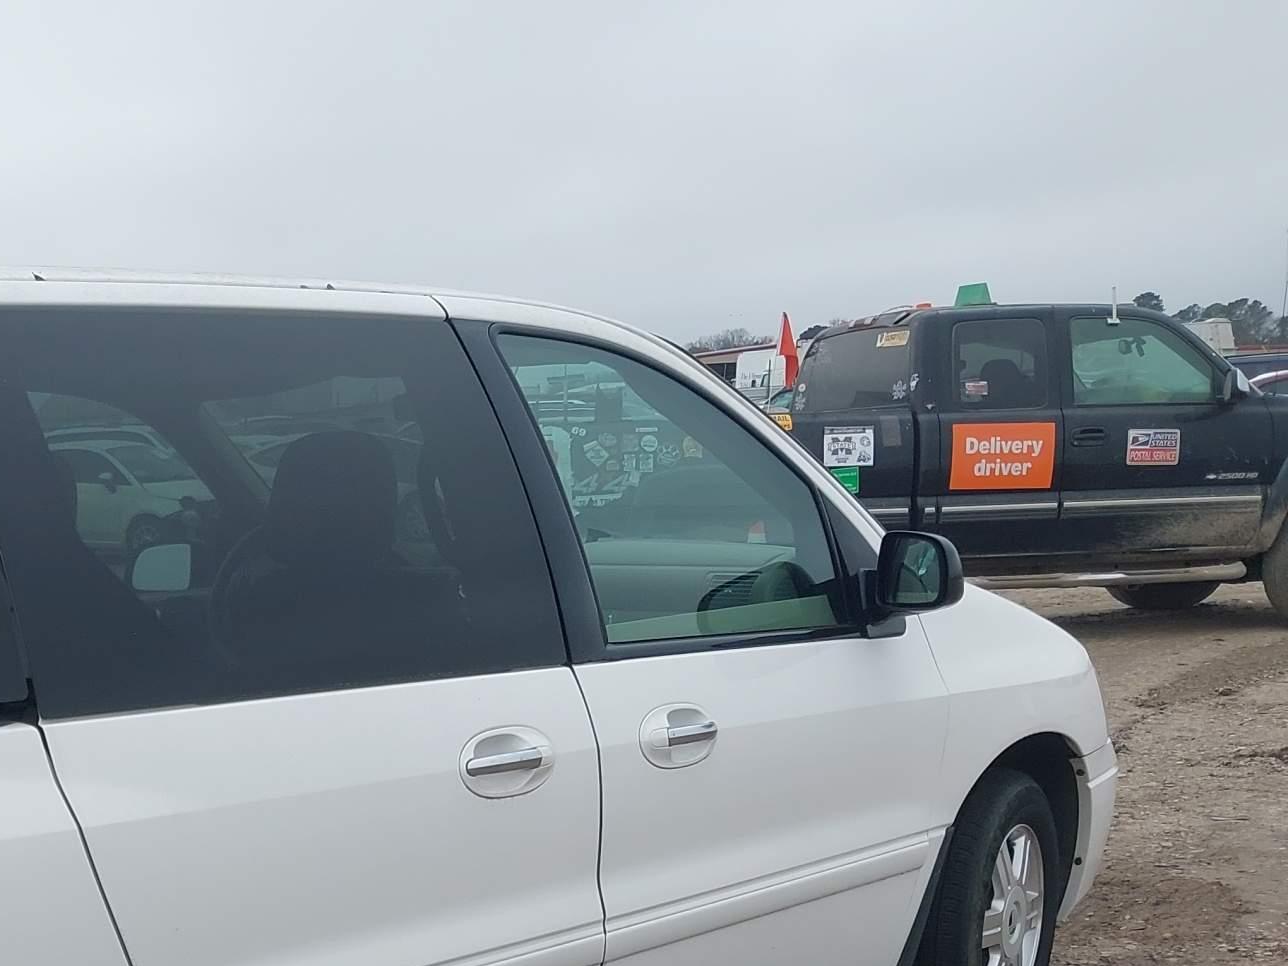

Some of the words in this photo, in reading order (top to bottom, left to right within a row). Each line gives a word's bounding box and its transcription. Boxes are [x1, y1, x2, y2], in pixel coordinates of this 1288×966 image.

[965, 436, 1043, 457] Delivery
[1130, 451, 1152, 461] POSTAL
[1152, 450, 1177, 461] SERVICE
[974, 459, 1032, 476] driver
